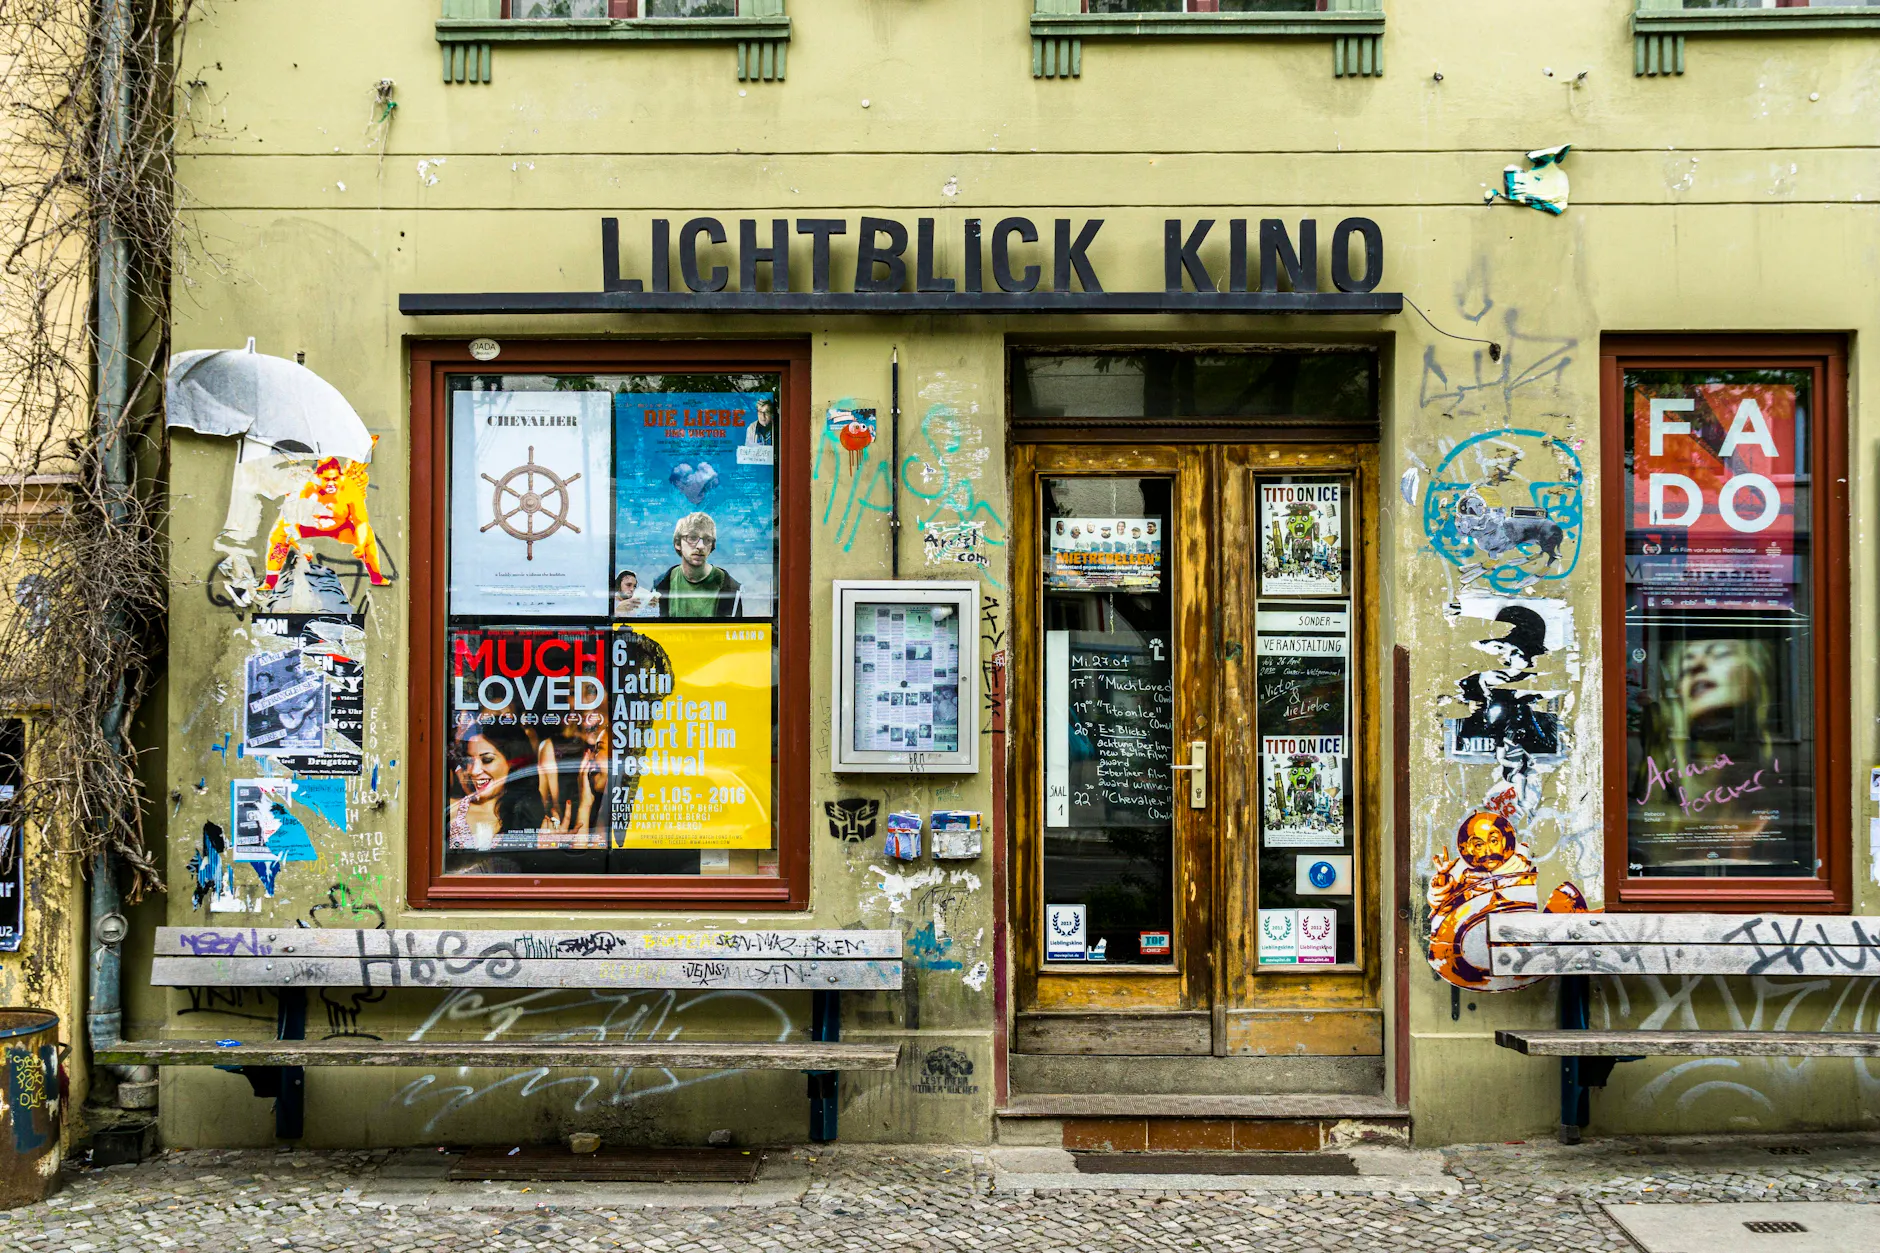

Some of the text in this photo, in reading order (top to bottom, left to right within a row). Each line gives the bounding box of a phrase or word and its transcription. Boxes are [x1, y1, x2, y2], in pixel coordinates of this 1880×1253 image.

[602, 216, 1385, 294] LICHTBLICK KINO
[487, 415, 578, 427] CHEVALIER
[643, 409, 746, 427] DIE LIEBE
[688, 429, 727, 438] VIKTOR
[1263, 486, 1339, 503] TITO ON ICE
[1056, 552, 1155, 565] MIETREBELLEN
[726, 630, 765, 641] LAKINO
[612, 639, 636, 666] 6.
[1263, 638, 1342, 653] VERANSTALTUNG
[454, 639, 605, 681] MUCH
[612, 667, 672, 694] Latin
[454, 675, 605, 711] LOVED
[1289, 688, 1301, 705] &
[612, 694, 727, 721] American
[1300, 697, 1330, 715] Liebe
[612, 721, 736, 749] Short Film
[1265, 738, 1340, 754] TITO ON ICE
[307, 758, 358, 767] Drugstore
[612, 748, 705, 776] Festival
[1099, 758, 1130, 767] award
[1049, 785, 1067, 797] SAAL
[1097, 779, 1129, 788] award
[612, 786, 645, 804] 27.4
[660, 787, 692, 804] 1.05
[709, 787, 746, 804] 2016
[612, 804, 660, 812] LICHTBLICK
[662, 804, 683, 812] KINO
[1058, 804, 1063, 816] 1
[612, 813, 648, 821] SPUTNIK
[612, 821, 633, 830] MAZE
[636, 821, 662, 829] PARTY
[1144, 936, 1165, 946] TOP
